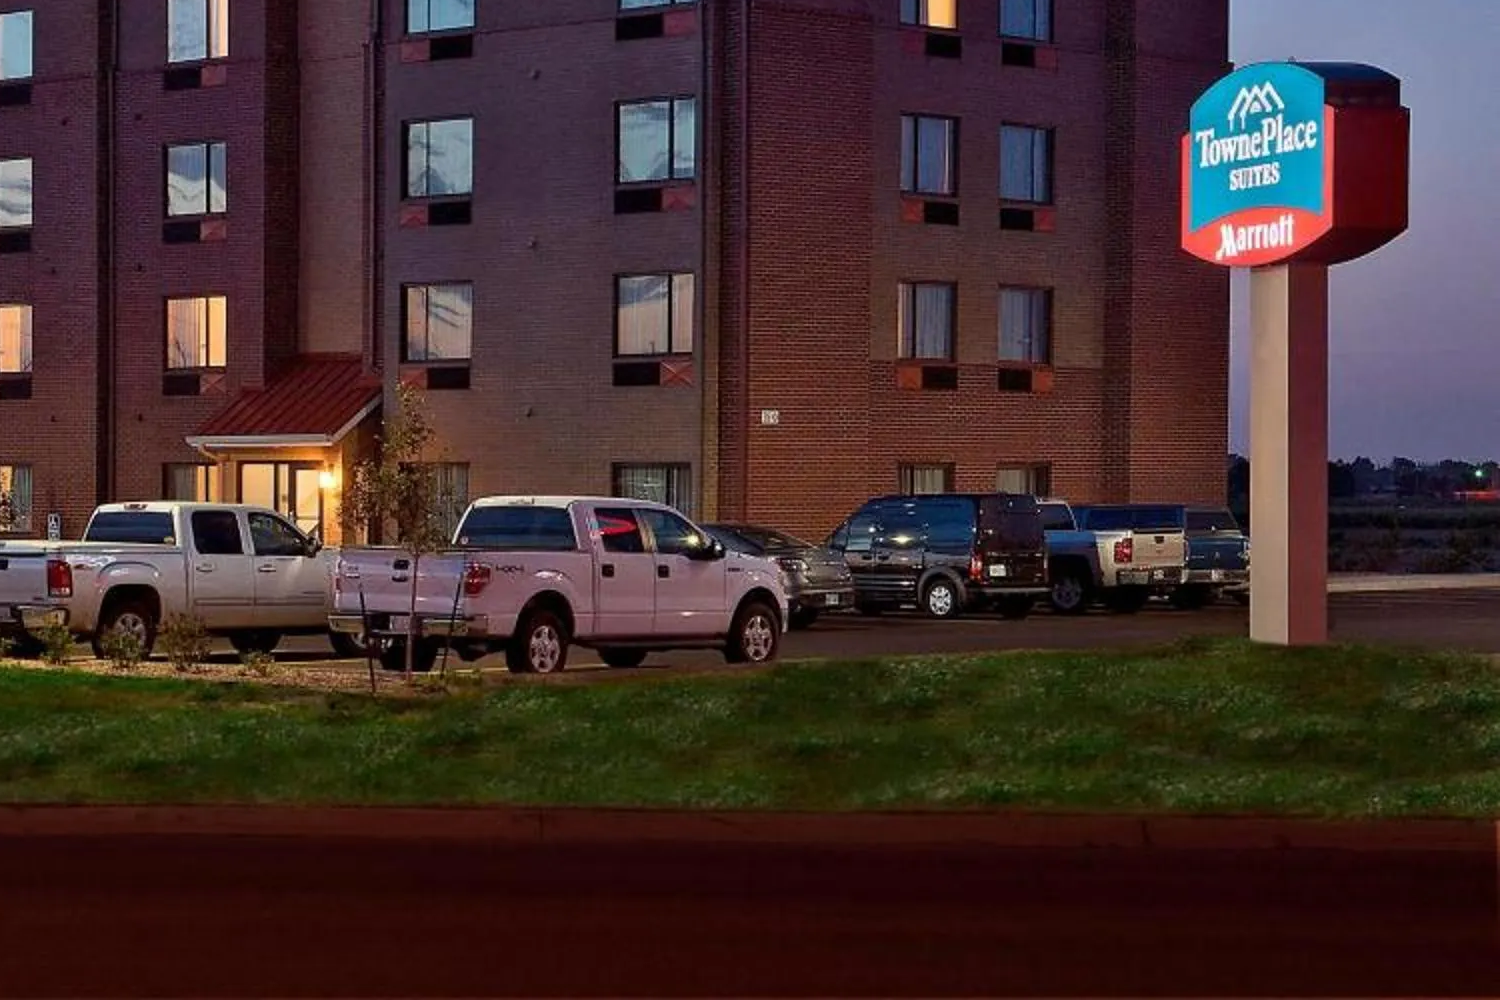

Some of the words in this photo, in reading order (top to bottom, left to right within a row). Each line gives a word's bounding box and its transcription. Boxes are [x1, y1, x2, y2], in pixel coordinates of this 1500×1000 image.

[1196, 114, 1317, 168] TownePlace
[1229, 162, 1280, 190] SUITES
[1216, 214, 1294, 260] Marriott
